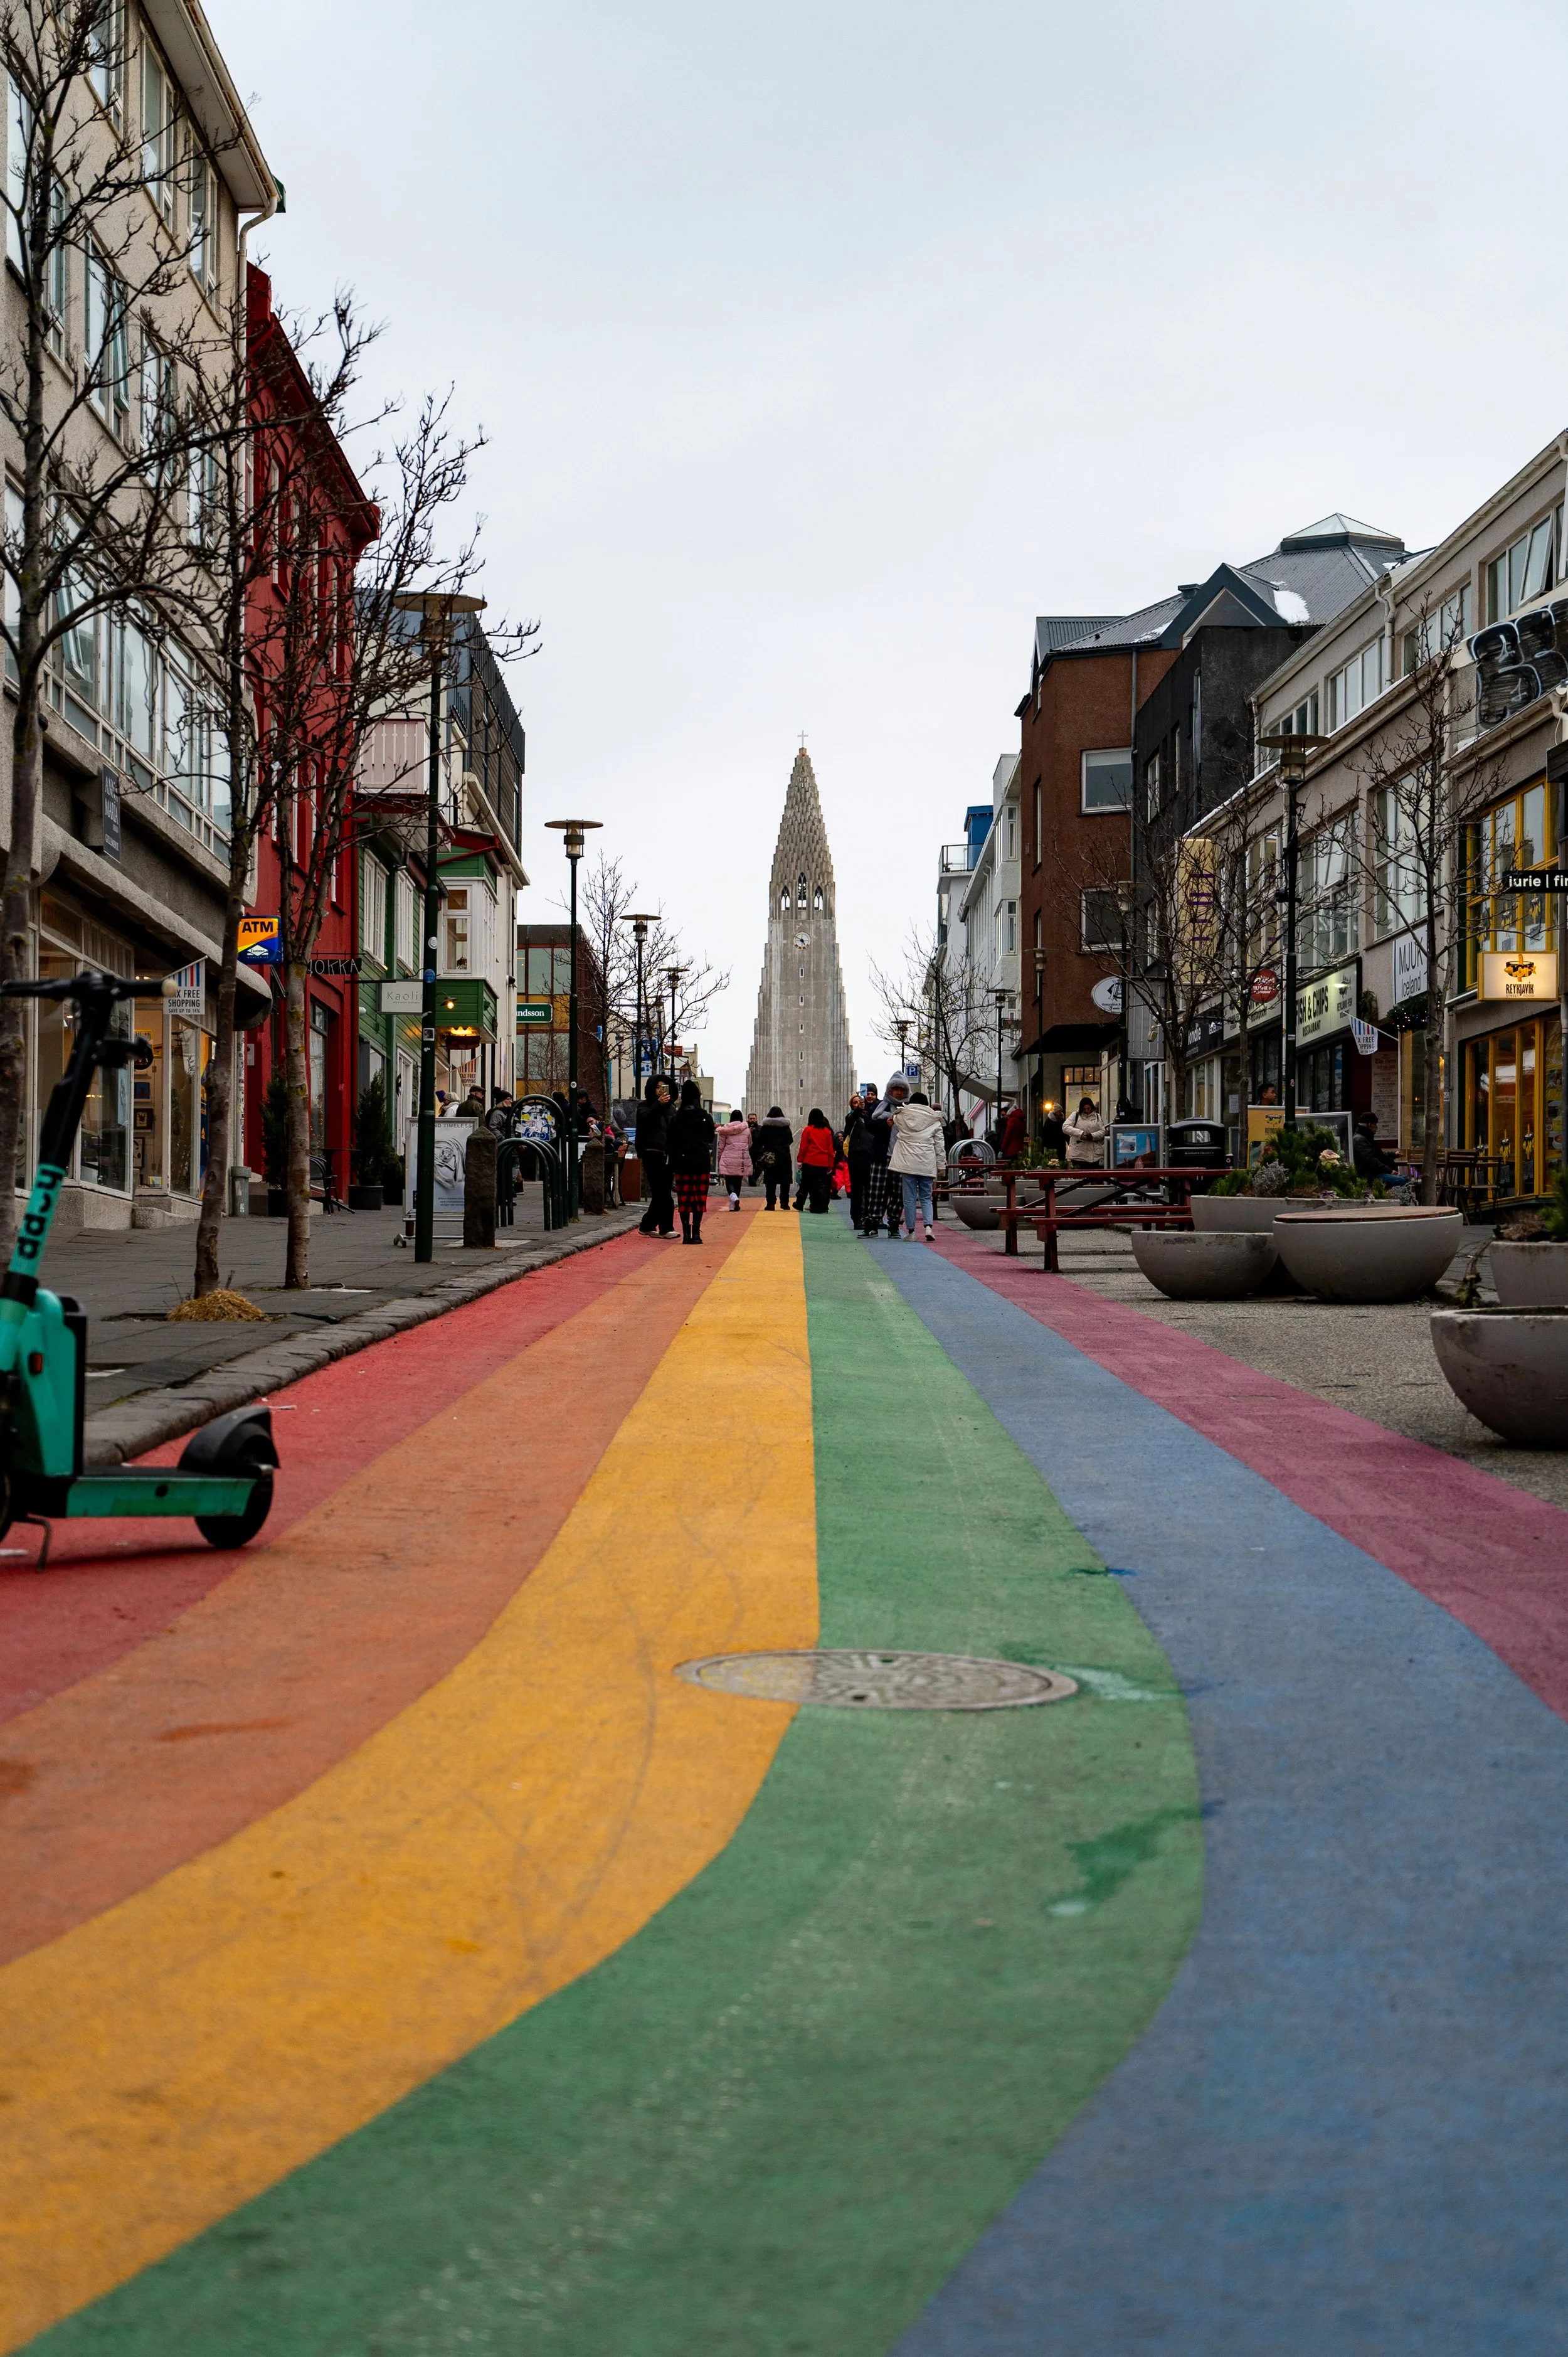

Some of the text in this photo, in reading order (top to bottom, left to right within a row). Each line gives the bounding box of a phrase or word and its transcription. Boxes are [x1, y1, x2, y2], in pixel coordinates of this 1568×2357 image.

[242, 922, 273, 932] ATM
[1402, 971, 1421, 998] Iceland
[1506, 982, 1534, 996] REYKJAVÍK
[184, 989, 200, 998] FREE
[168, 999, 200, 1008] SHOPPING
[1308, 995, 1312, 1021] &
[1313, 985, 1328, 1018] CHIPS
[1303, 1019, 1321, 1036] RESTAURANT
[909, 1067, 916, 1075] P
